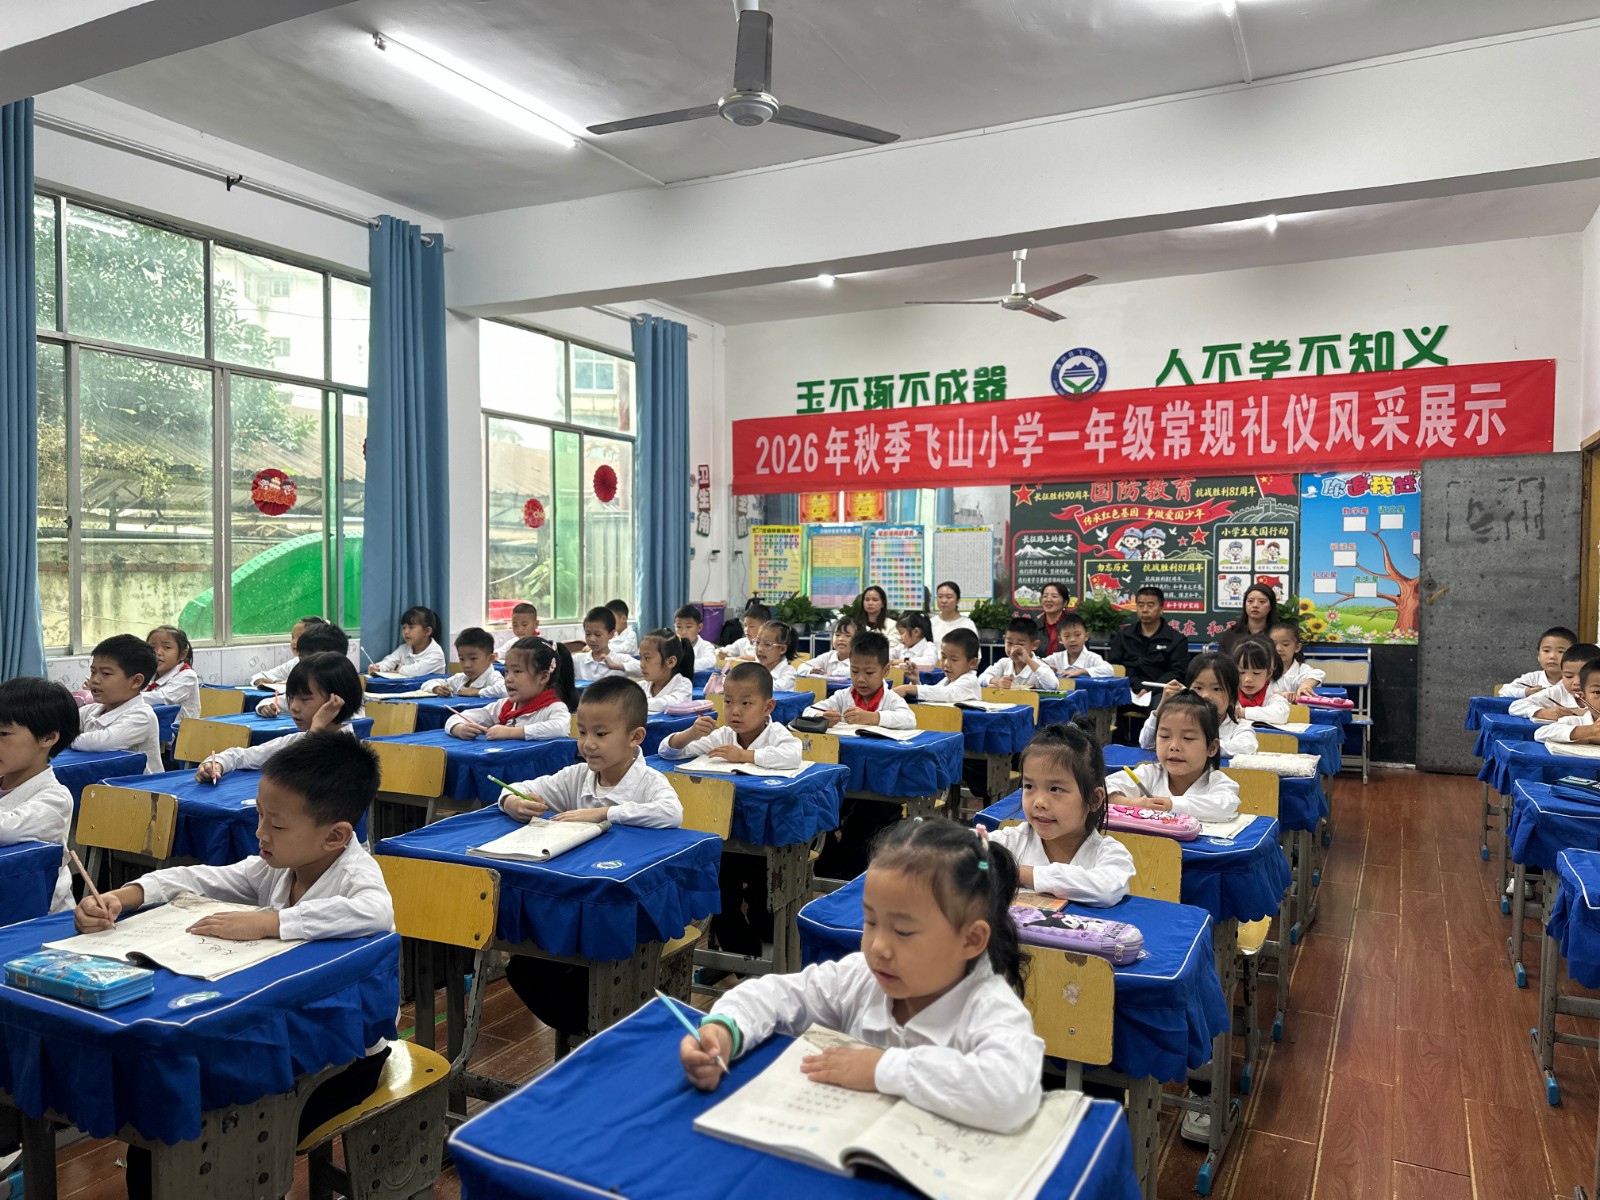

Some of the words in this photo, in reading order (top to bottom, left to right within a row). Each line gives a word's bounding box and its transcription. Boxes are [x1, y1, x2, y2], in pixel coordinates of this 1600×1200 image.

[1155, 324, 1449, 387] 人不学不知义
[796, 365, 1007, 414] 玉不琢不成器
[755, 382, 1507, 477] 2026年秋季飞山小学一年级常规礼仪风采展示
[1090, 476, 1197, 503] 国防教育
[1194, 486, 1257, 498] 抗战胜利81周年
[1034, 490, 1090, 502] 长征胜利90周年
[1145, 508, 1205, 521] 争做爱国少年
[1221, 526, 1289, 538] 小学生爱国行动
[1022, 534, 1074, 545] 长征路上的故事
[1097, 562, 1131, 573] 勿忘历史
[1142, 563, 1204, 574] 抗战胜利81周年
